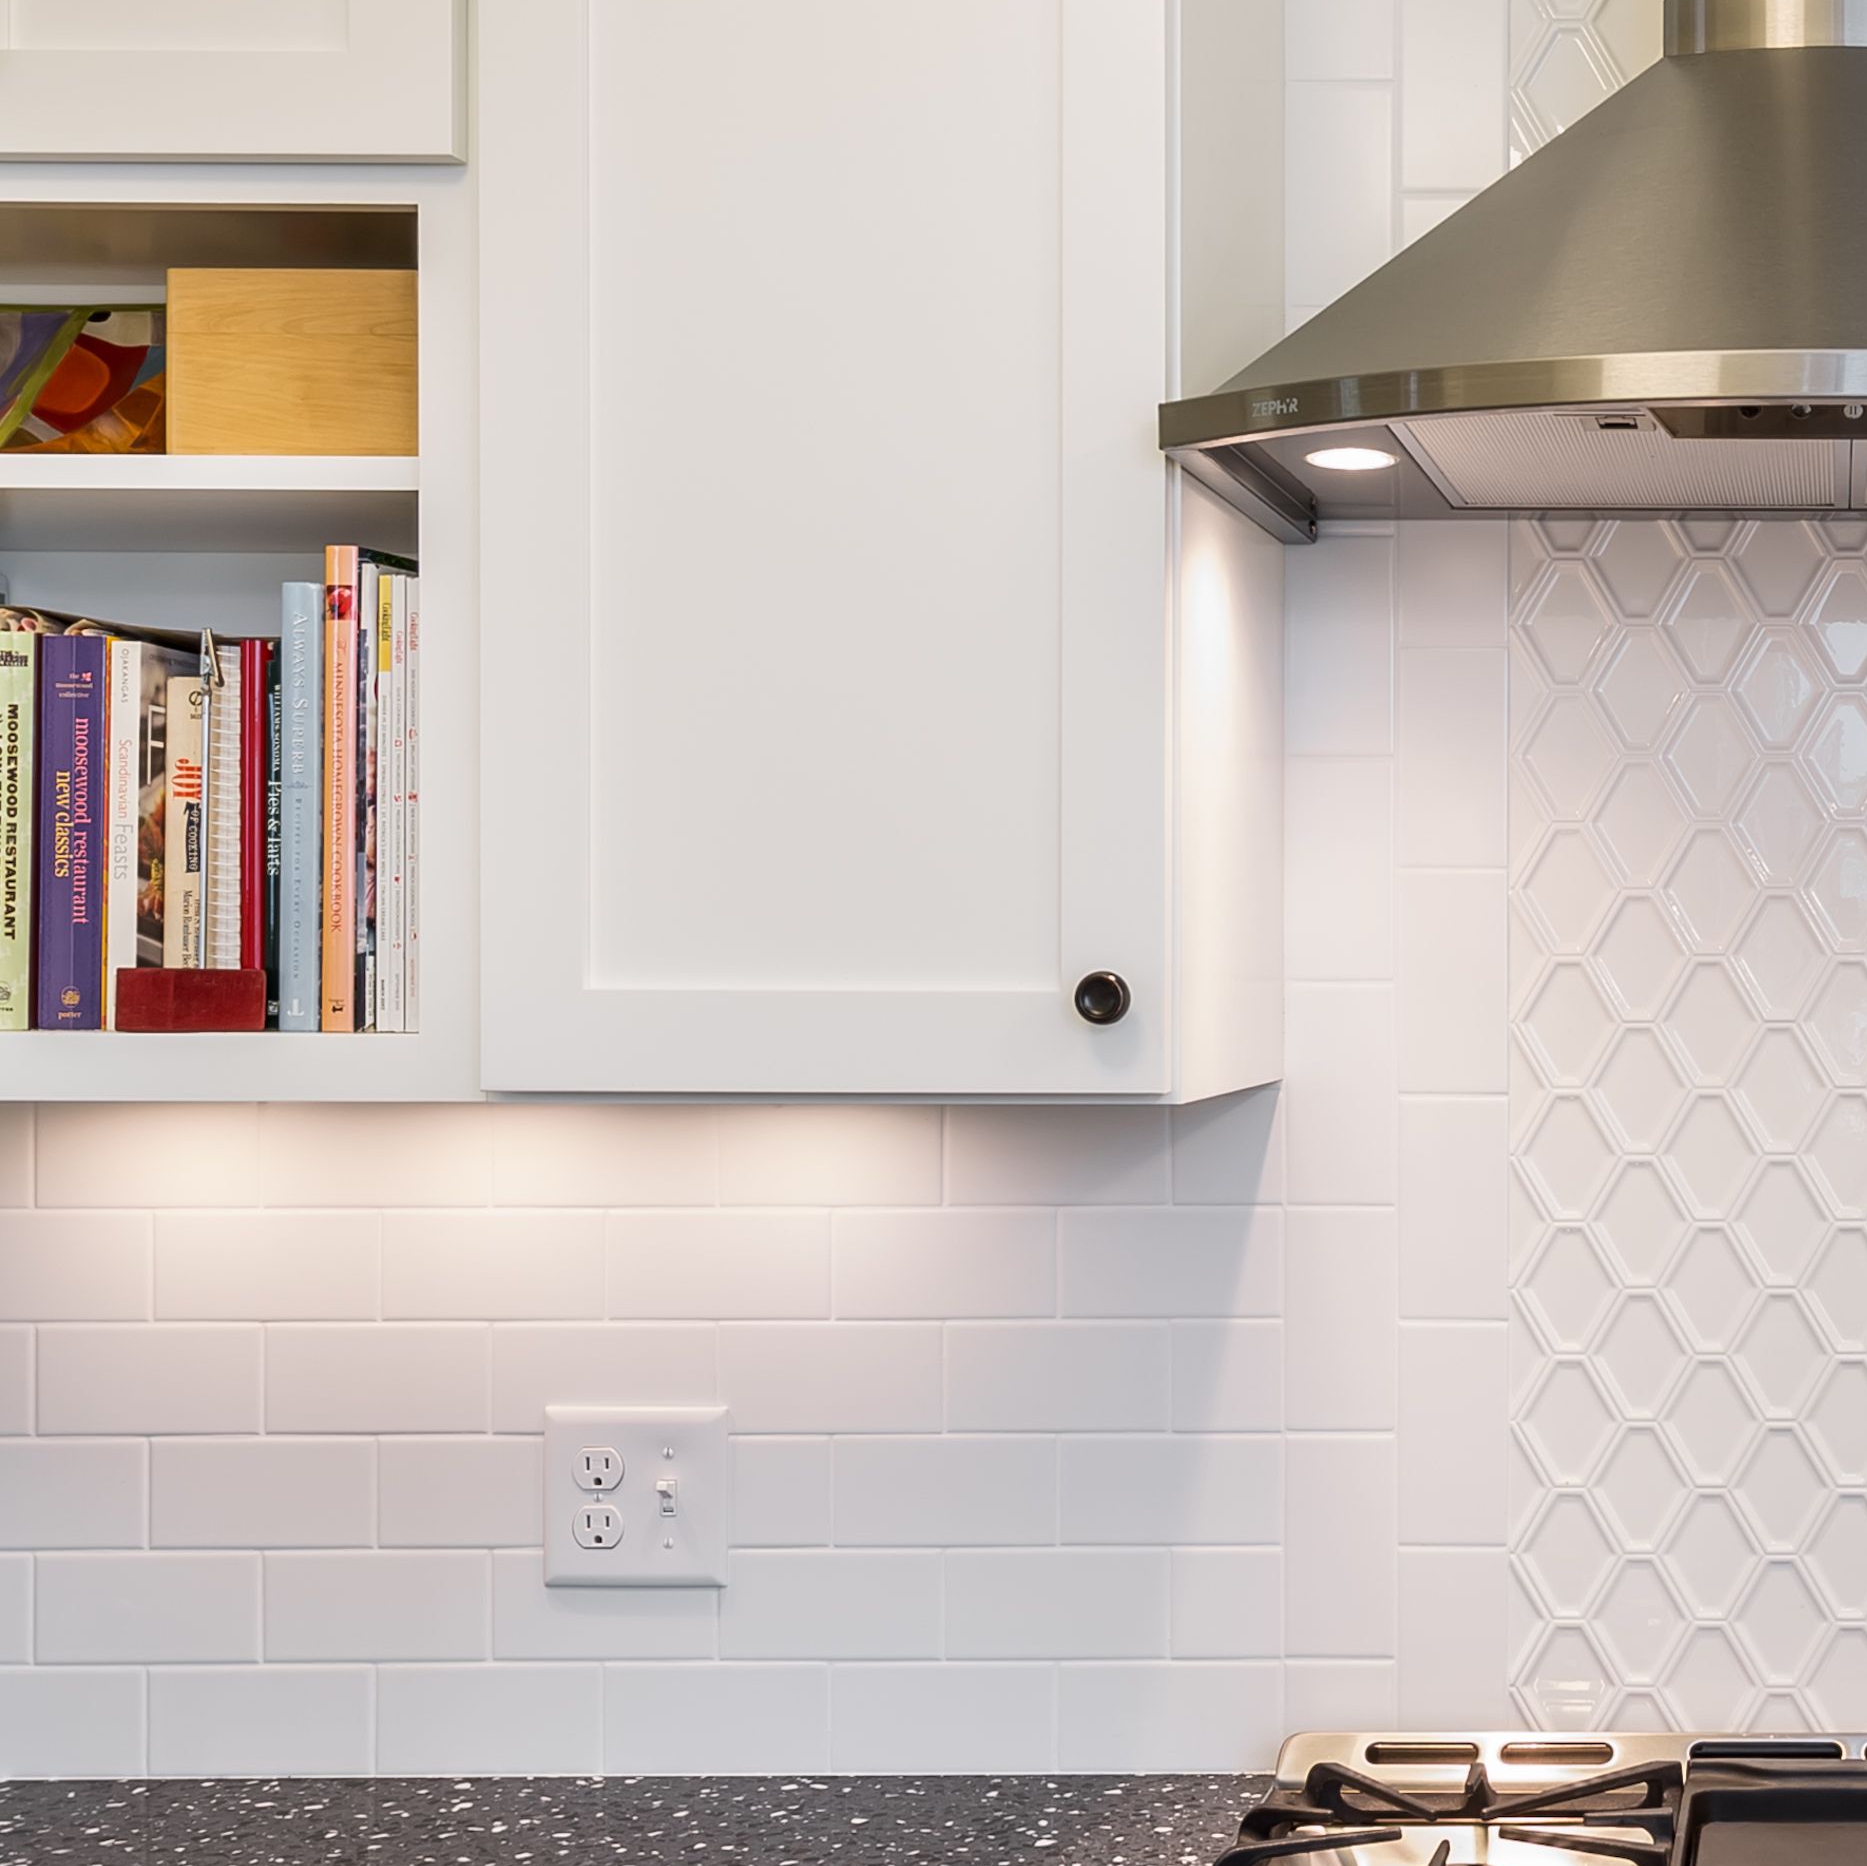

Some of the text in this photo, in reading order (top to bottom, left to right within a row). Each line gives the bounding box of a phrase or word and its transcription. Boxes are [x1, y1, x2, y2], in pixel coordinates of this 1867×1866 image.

[119, 648, 129, 703] OJAKANGAS
[291, 611, 308, 773] ALWAYS SUPERB
[332, 661, 344, 743] MINNESOTA
[4, 704, 18, 940] MOOSEWOOD RESTAURANT
[54, 771, 74, 878] new classics
[72, 717, 92, 924] moosewood restaurant
[113, 739, 134, 880] Scandinavian Feasts
[172, 758, 202, 803] JOY
[267, 780, 282, 876] Pies & Tarts
[332, 749, 344, 846] HOMEGROWN
[188, 825, 199, 871] COOKING
[330, 851, 342, 933] COOKBOOK
